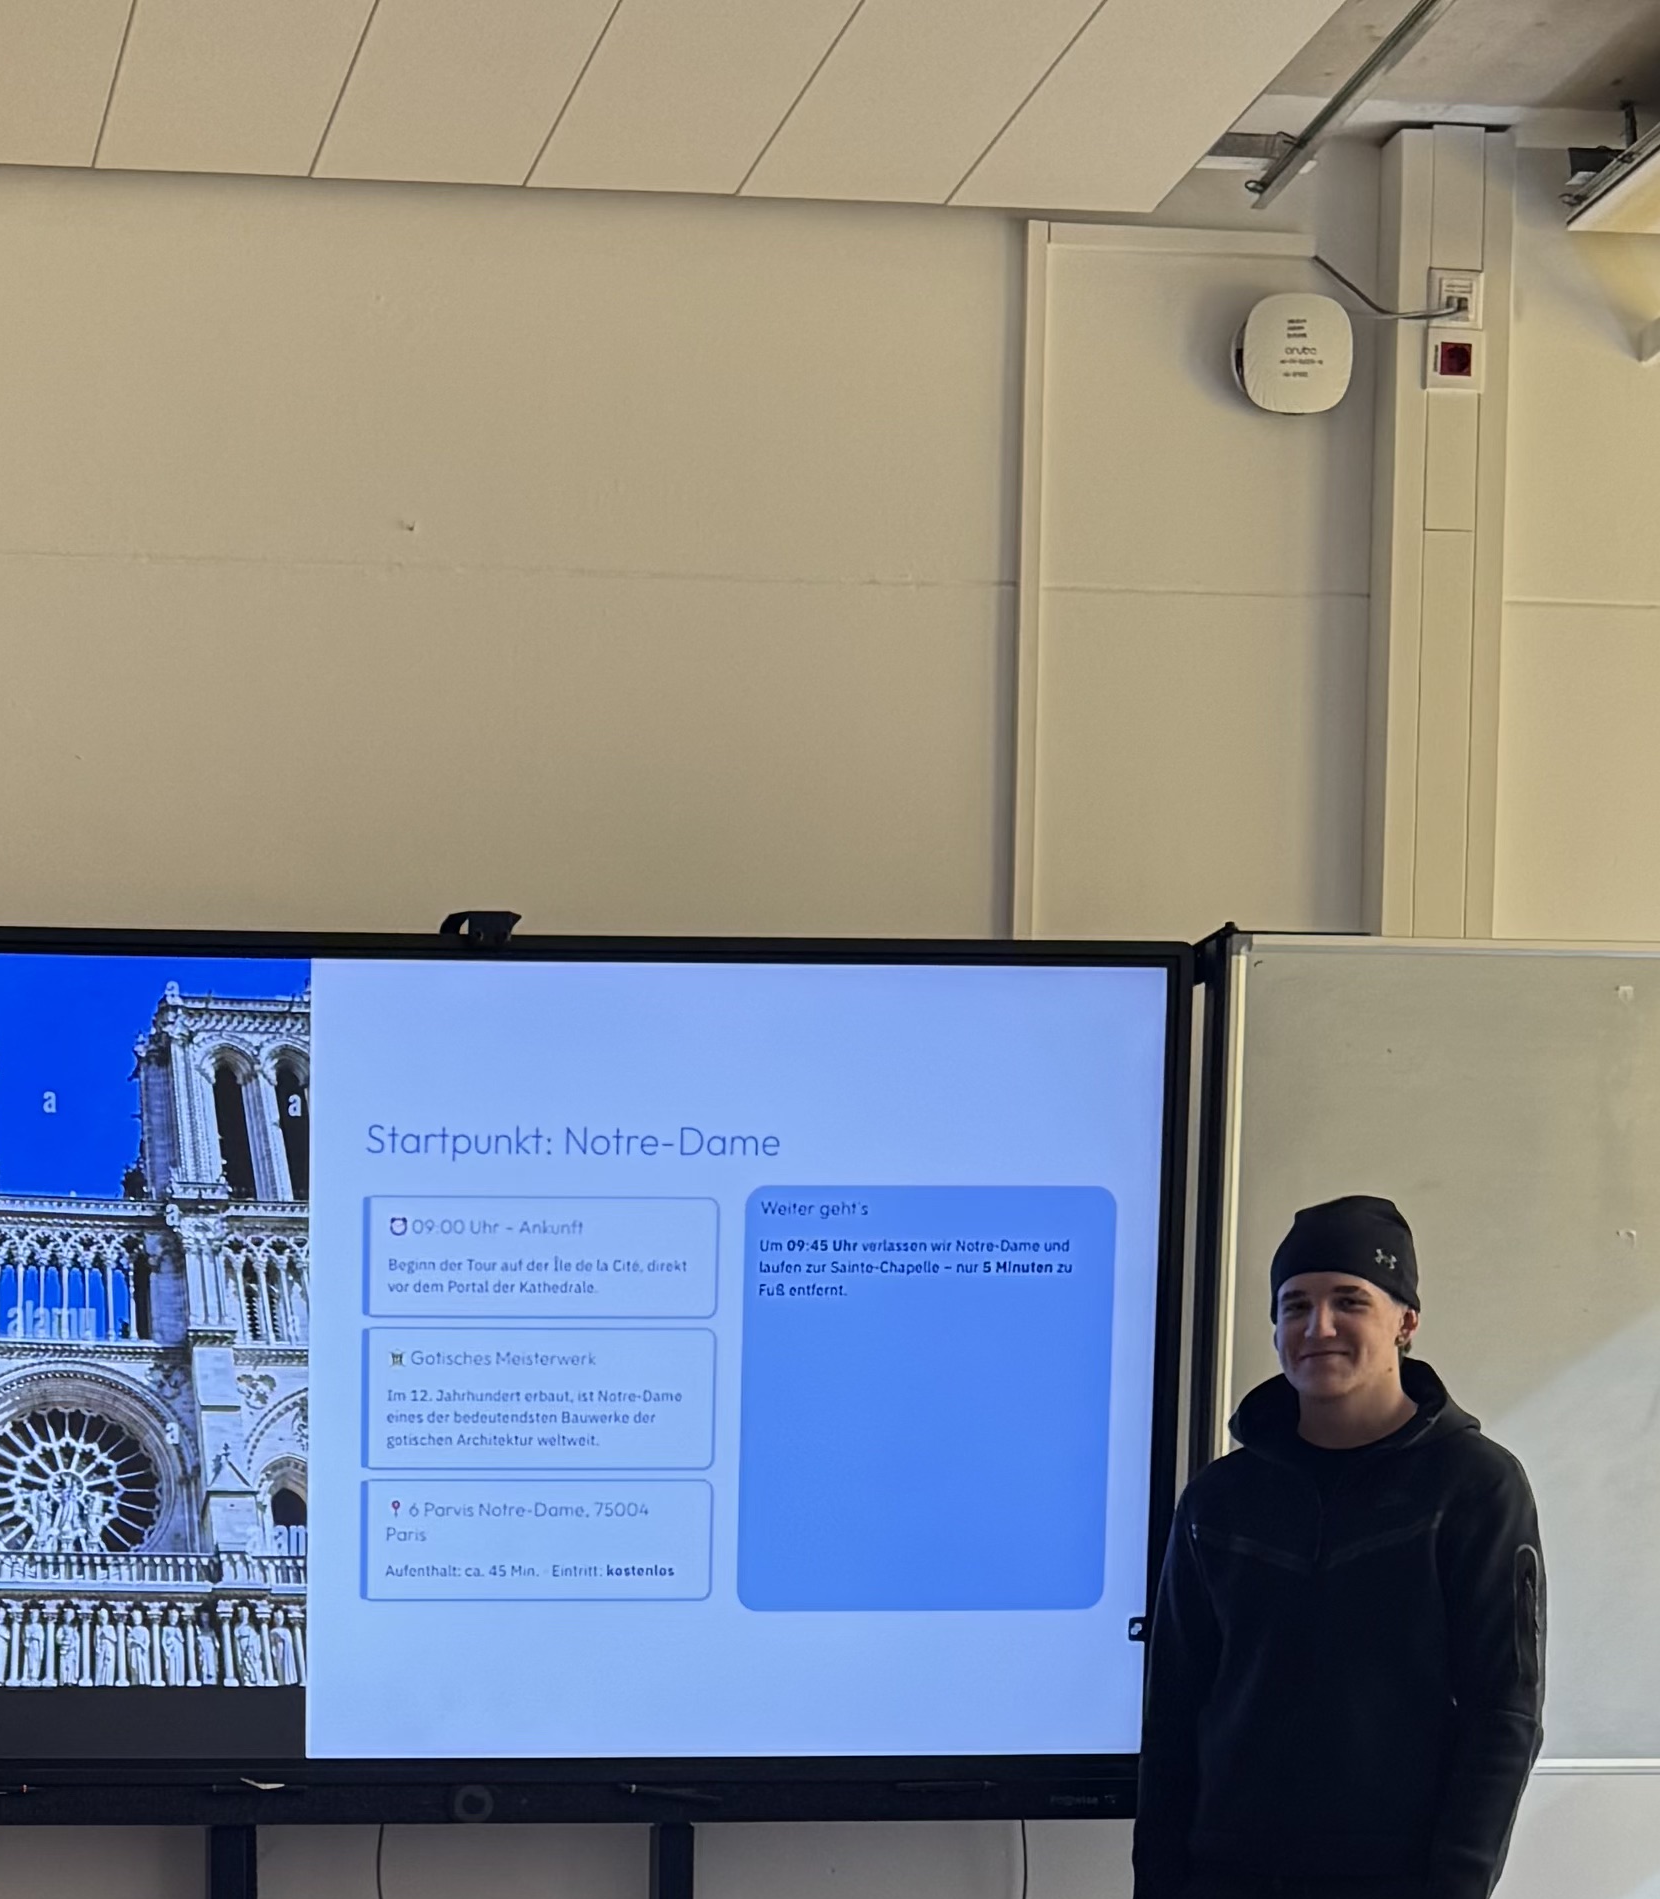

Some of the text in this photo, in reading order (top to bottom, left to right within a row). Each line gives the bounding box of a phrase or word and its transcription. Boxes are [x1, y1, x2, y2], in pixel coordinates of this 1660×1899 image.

[42, 1088, 57, 1113] a
[287, 1094, 301, 1117] a
[366, 1124, 780, 1162] Startpunkt: Notre-Dame
[165, 1204, 180, 1227] a
[760, 1200, 815, 1216] Weiter
[411, 1218, 466, 1235] 09:00
[469, 1219, 500, 1236] Uhr
[519, 1219, 583, 1235] Ankunft
[759, 1239, 1070, 1253] Um 09:45 Uhr verlassen wir Notre-Dame und
[388, 1258, 436, 1275] Beginn
[439, 1259, 463, 1272] der
[466, 1258, 497, 1272] Tour
[500, 1258, 523, 1272] auf
[526, 1259, 549, 1272] der
[575, 1259, 593, 1272] de
[596, 1259, 609, 1272] la
[612, 1259, 644, 1273] Cité,
[647, 1259, 687, 1272] direkt
[759, 1260, 802, 1274] laufen
[805, 1263, 827, 1274] zur
[830, 1260, 941, 1277] Sainte-Chapelle
[956, 1263, 980, 1274] nur
[983, 1261, 992, 1274] 5
[995, 1260, 1054, 1274] Minuten
[1056, 1263, 1073, 1274] zu
[387, 1282, 411, 1294] vor
[412, 1279, 444, 1293] dem
[448, 1279, 489, 1294] Portal
[492, 1279, 515, 1294] der
[759, 1283, 848, 1298] Fuß entfernt.
[410, 1350, 596, 1366] Gotisches Meisterwerk
[387, 1389, 682, 1404] Im 12. Jahrhundert erbaut, ist Notre-Dame
[386, 1410, 656, 1424] eines der bedeutendsten Bauwerke der
[165, 1421, 180, 1445] a
[386, 1433, 599, 1449] gotischen Architektur weltweit.
[408, 1501, 649, 1518] 6 Parvis Notre-Dame, 75004
[386, 1526, 427, 1542] Paris
[385, 1564, 461, 1577] Aufenthalt:
[464, 1567, 485, 1577] ca.
[488, 1564, 507, 1577] 45
[511, 1565, 539, 1577] Min.
[552, 1564, 604, 1577] Eintritt:
[606, 1564, 675, 1577] kostenlos
